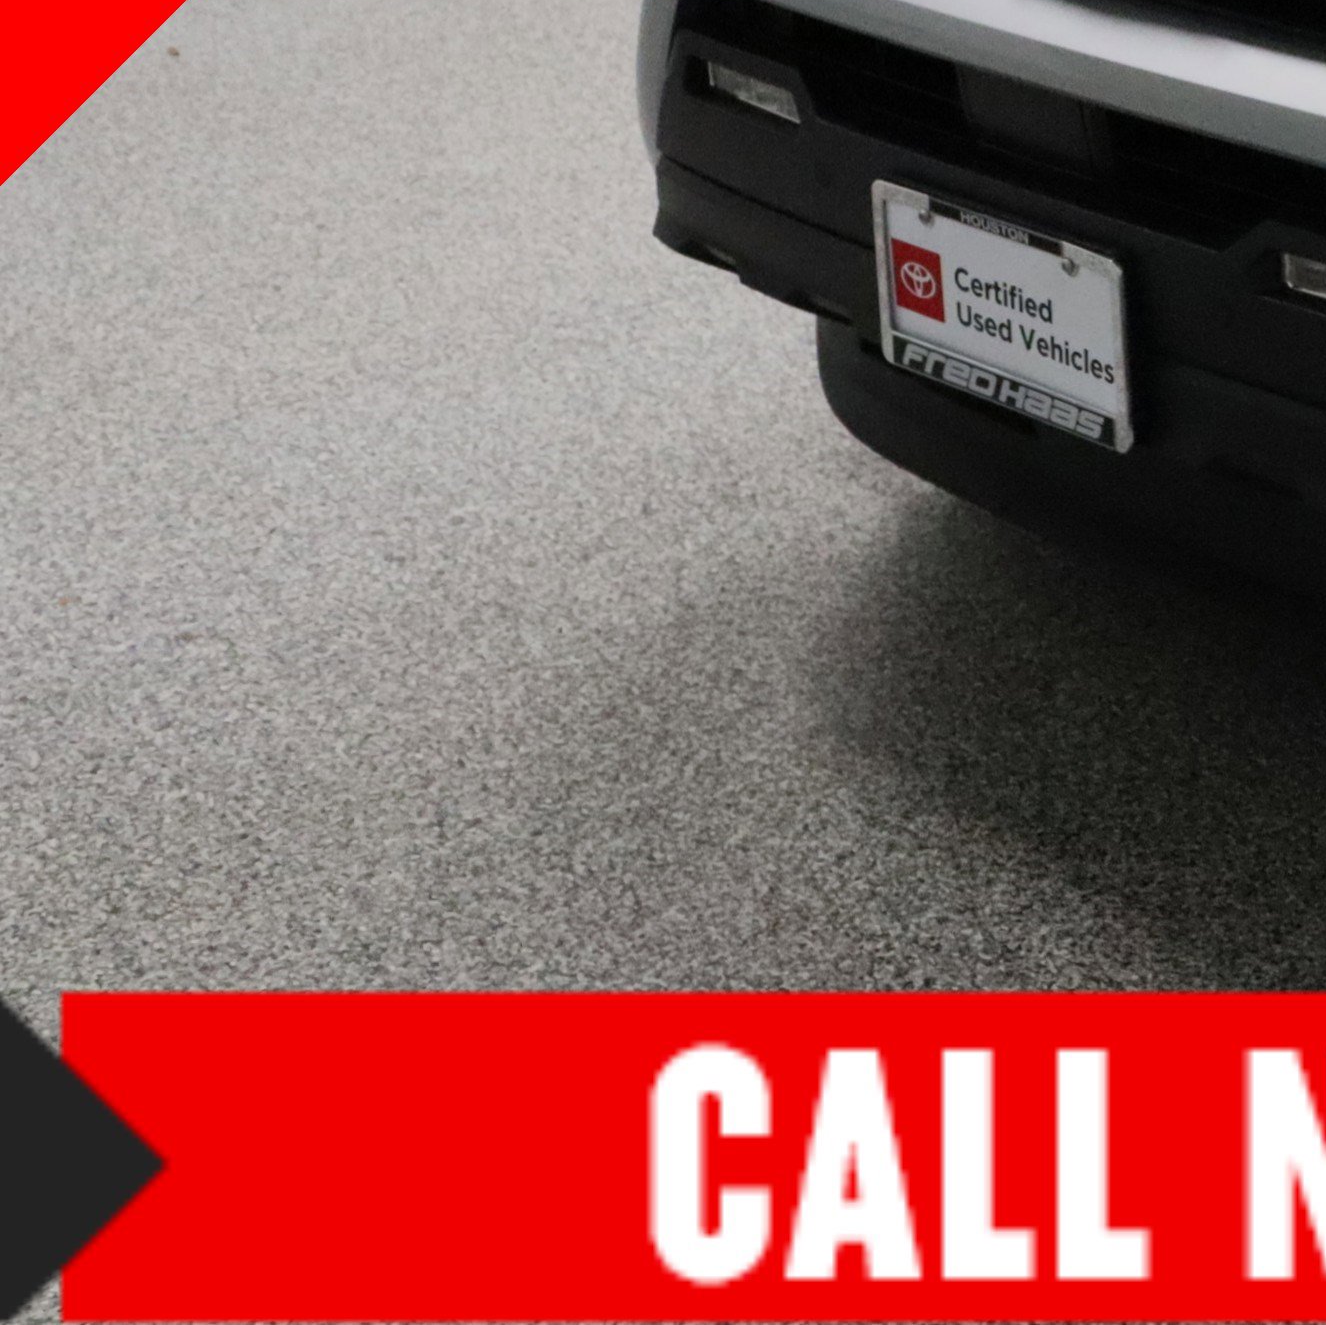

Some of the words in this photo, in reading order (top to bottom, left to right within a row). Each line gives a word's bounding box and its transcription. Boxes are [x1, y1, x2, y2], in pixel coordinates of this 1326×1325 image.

[960, 210, 1030, 245] HOUSTON
[954, 267, 1053, 324] Certified
[956, 302, 1013, 343] Used
[1019, 324, 1115, 384] Vehicles
